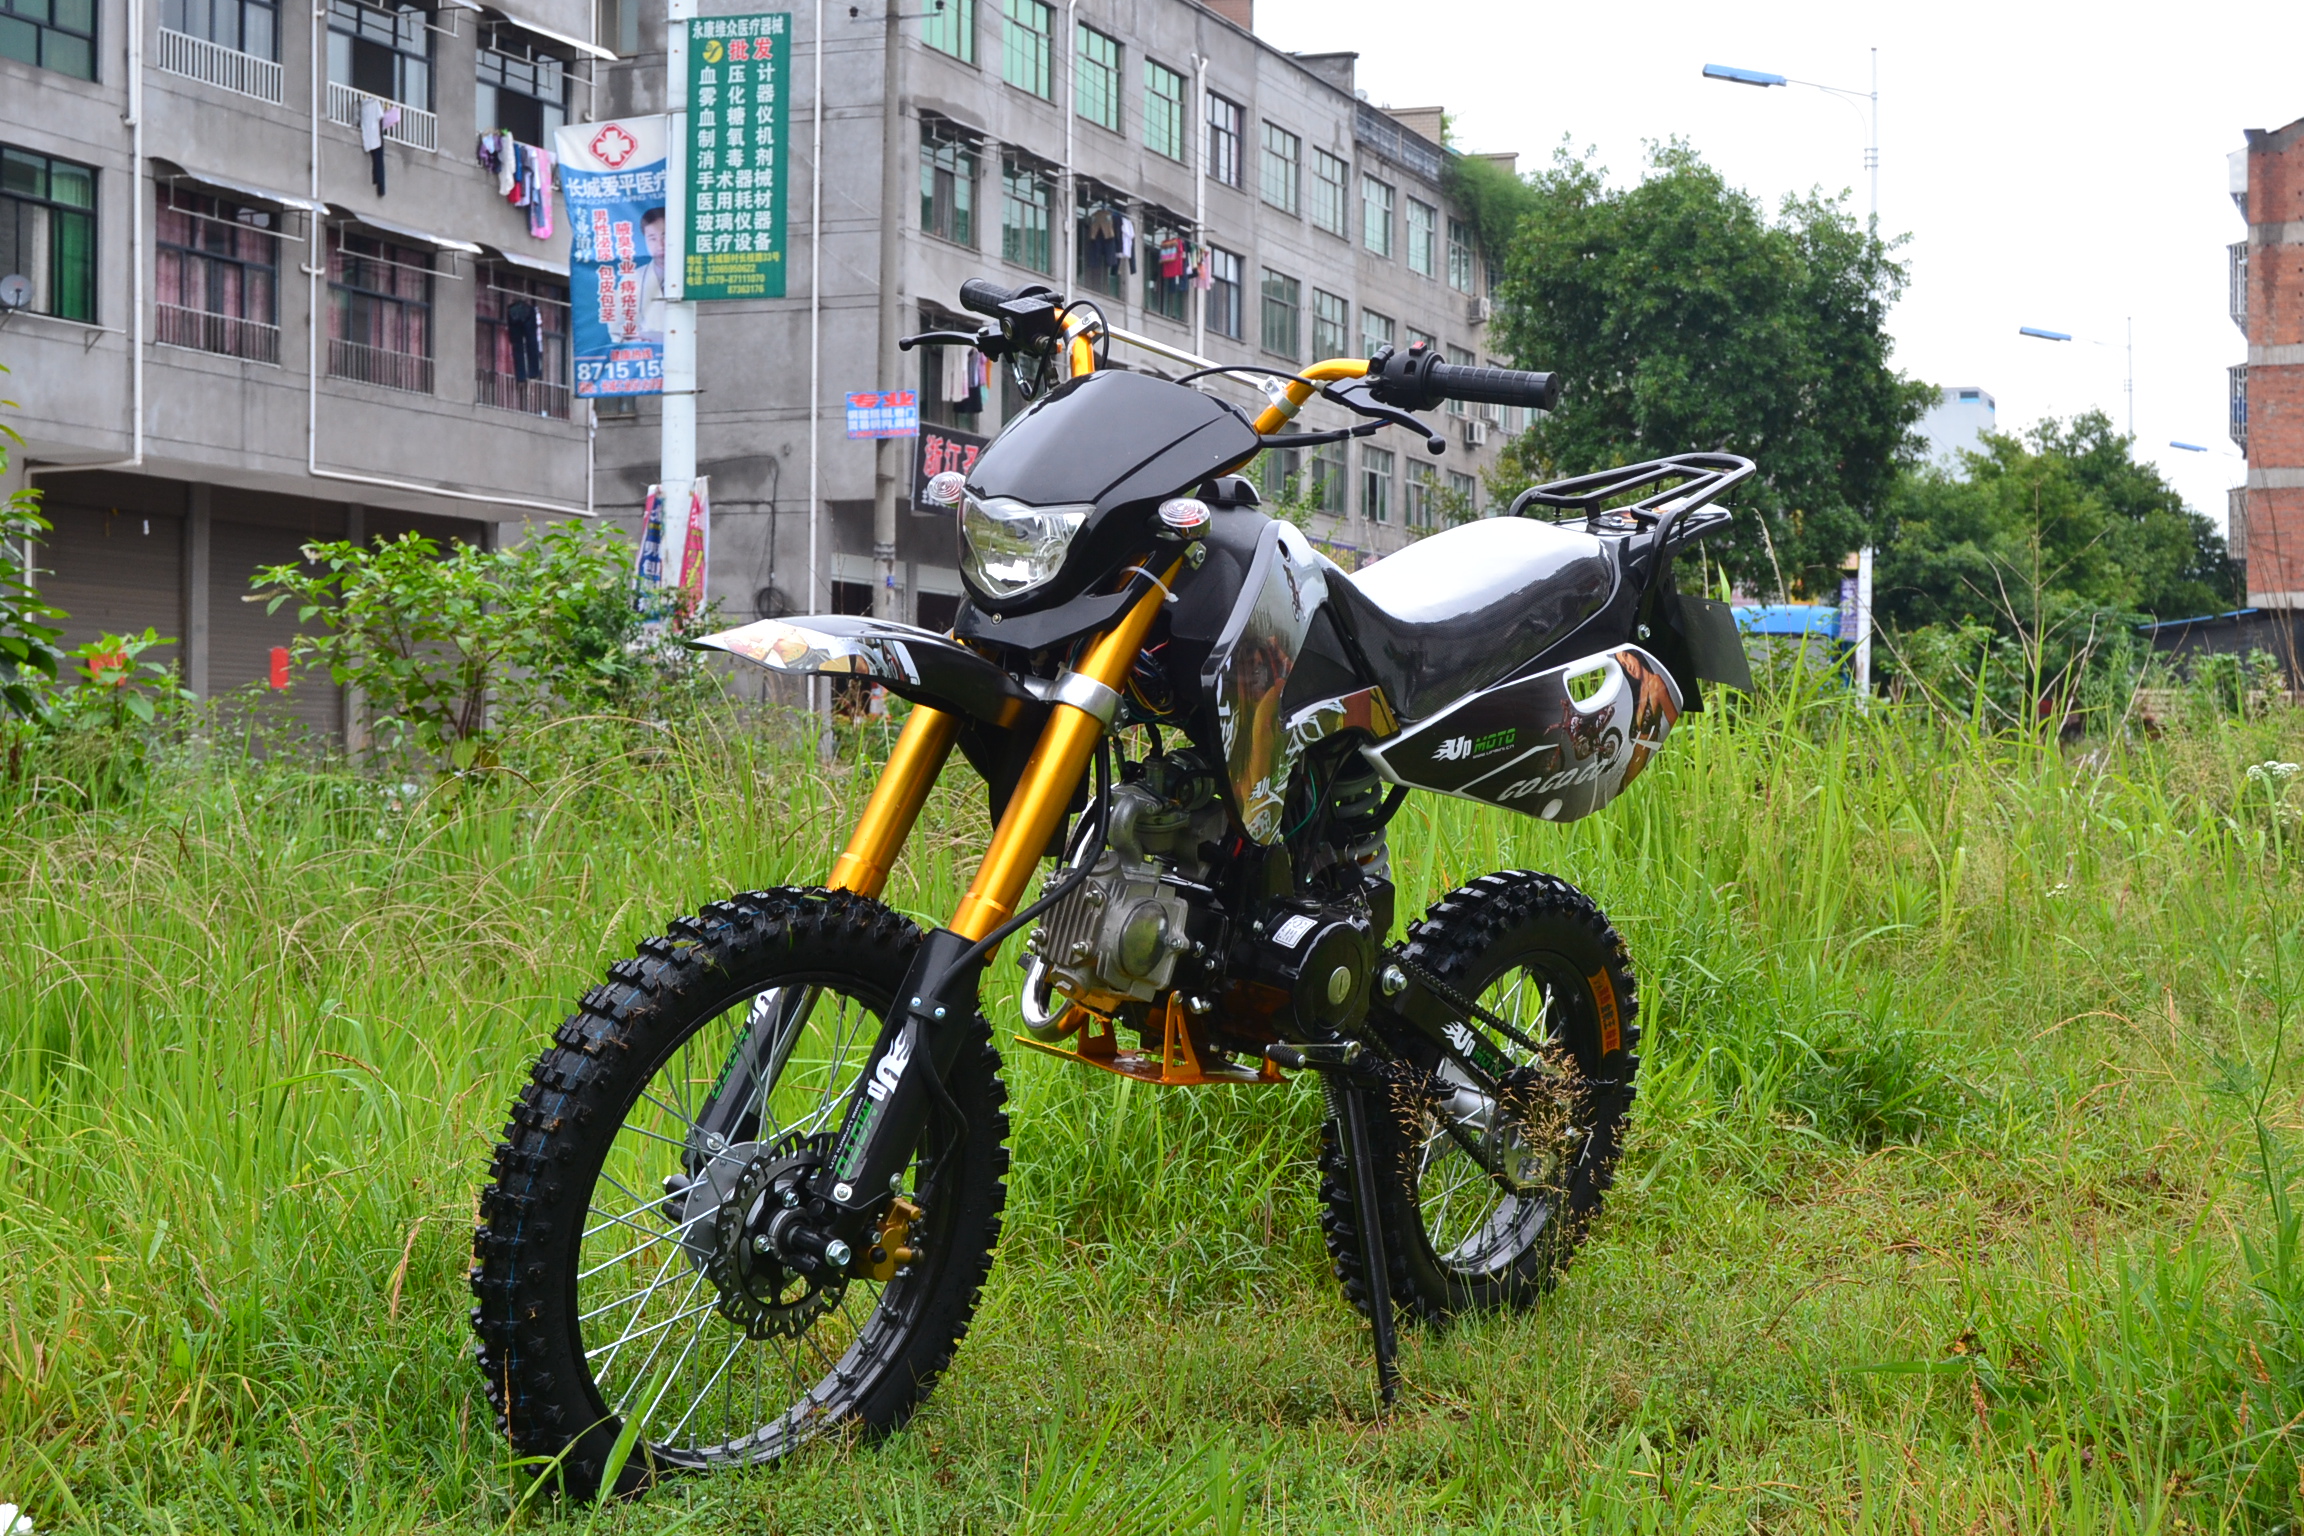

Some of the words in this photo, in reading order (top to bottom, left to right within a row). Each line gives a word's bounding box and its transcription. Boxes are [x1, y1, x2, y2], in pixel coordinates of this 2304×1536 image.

[692, 15, 784, 39] 永康维众医疗器械
[727, 37, 774, 61] 批发
[698, 62, 776, 85] 血压计
[698, 84, 775, 107] 雾化器
[697, 105, 774, 128] 血糖仪
[697, 126, 774, 148] 制氧机
[697, 147, 773, 169] 消毒剂
[696, 169, 773, 191] 手术器械
[696, 189, 773, 212] 医用耗材
[695, 210, 773, 233] 玻璃仪器
[592, 208, 615, 262] 男性泌尿
[695, 231, 773, 254] 医疗设备
[596, 265, 617, 324] 包皮包茎
[577, 361, 629, 381] 8715
[1473, 727, 1517, 753] MOTO
[834, 1101, 878, 1180] MOTO
